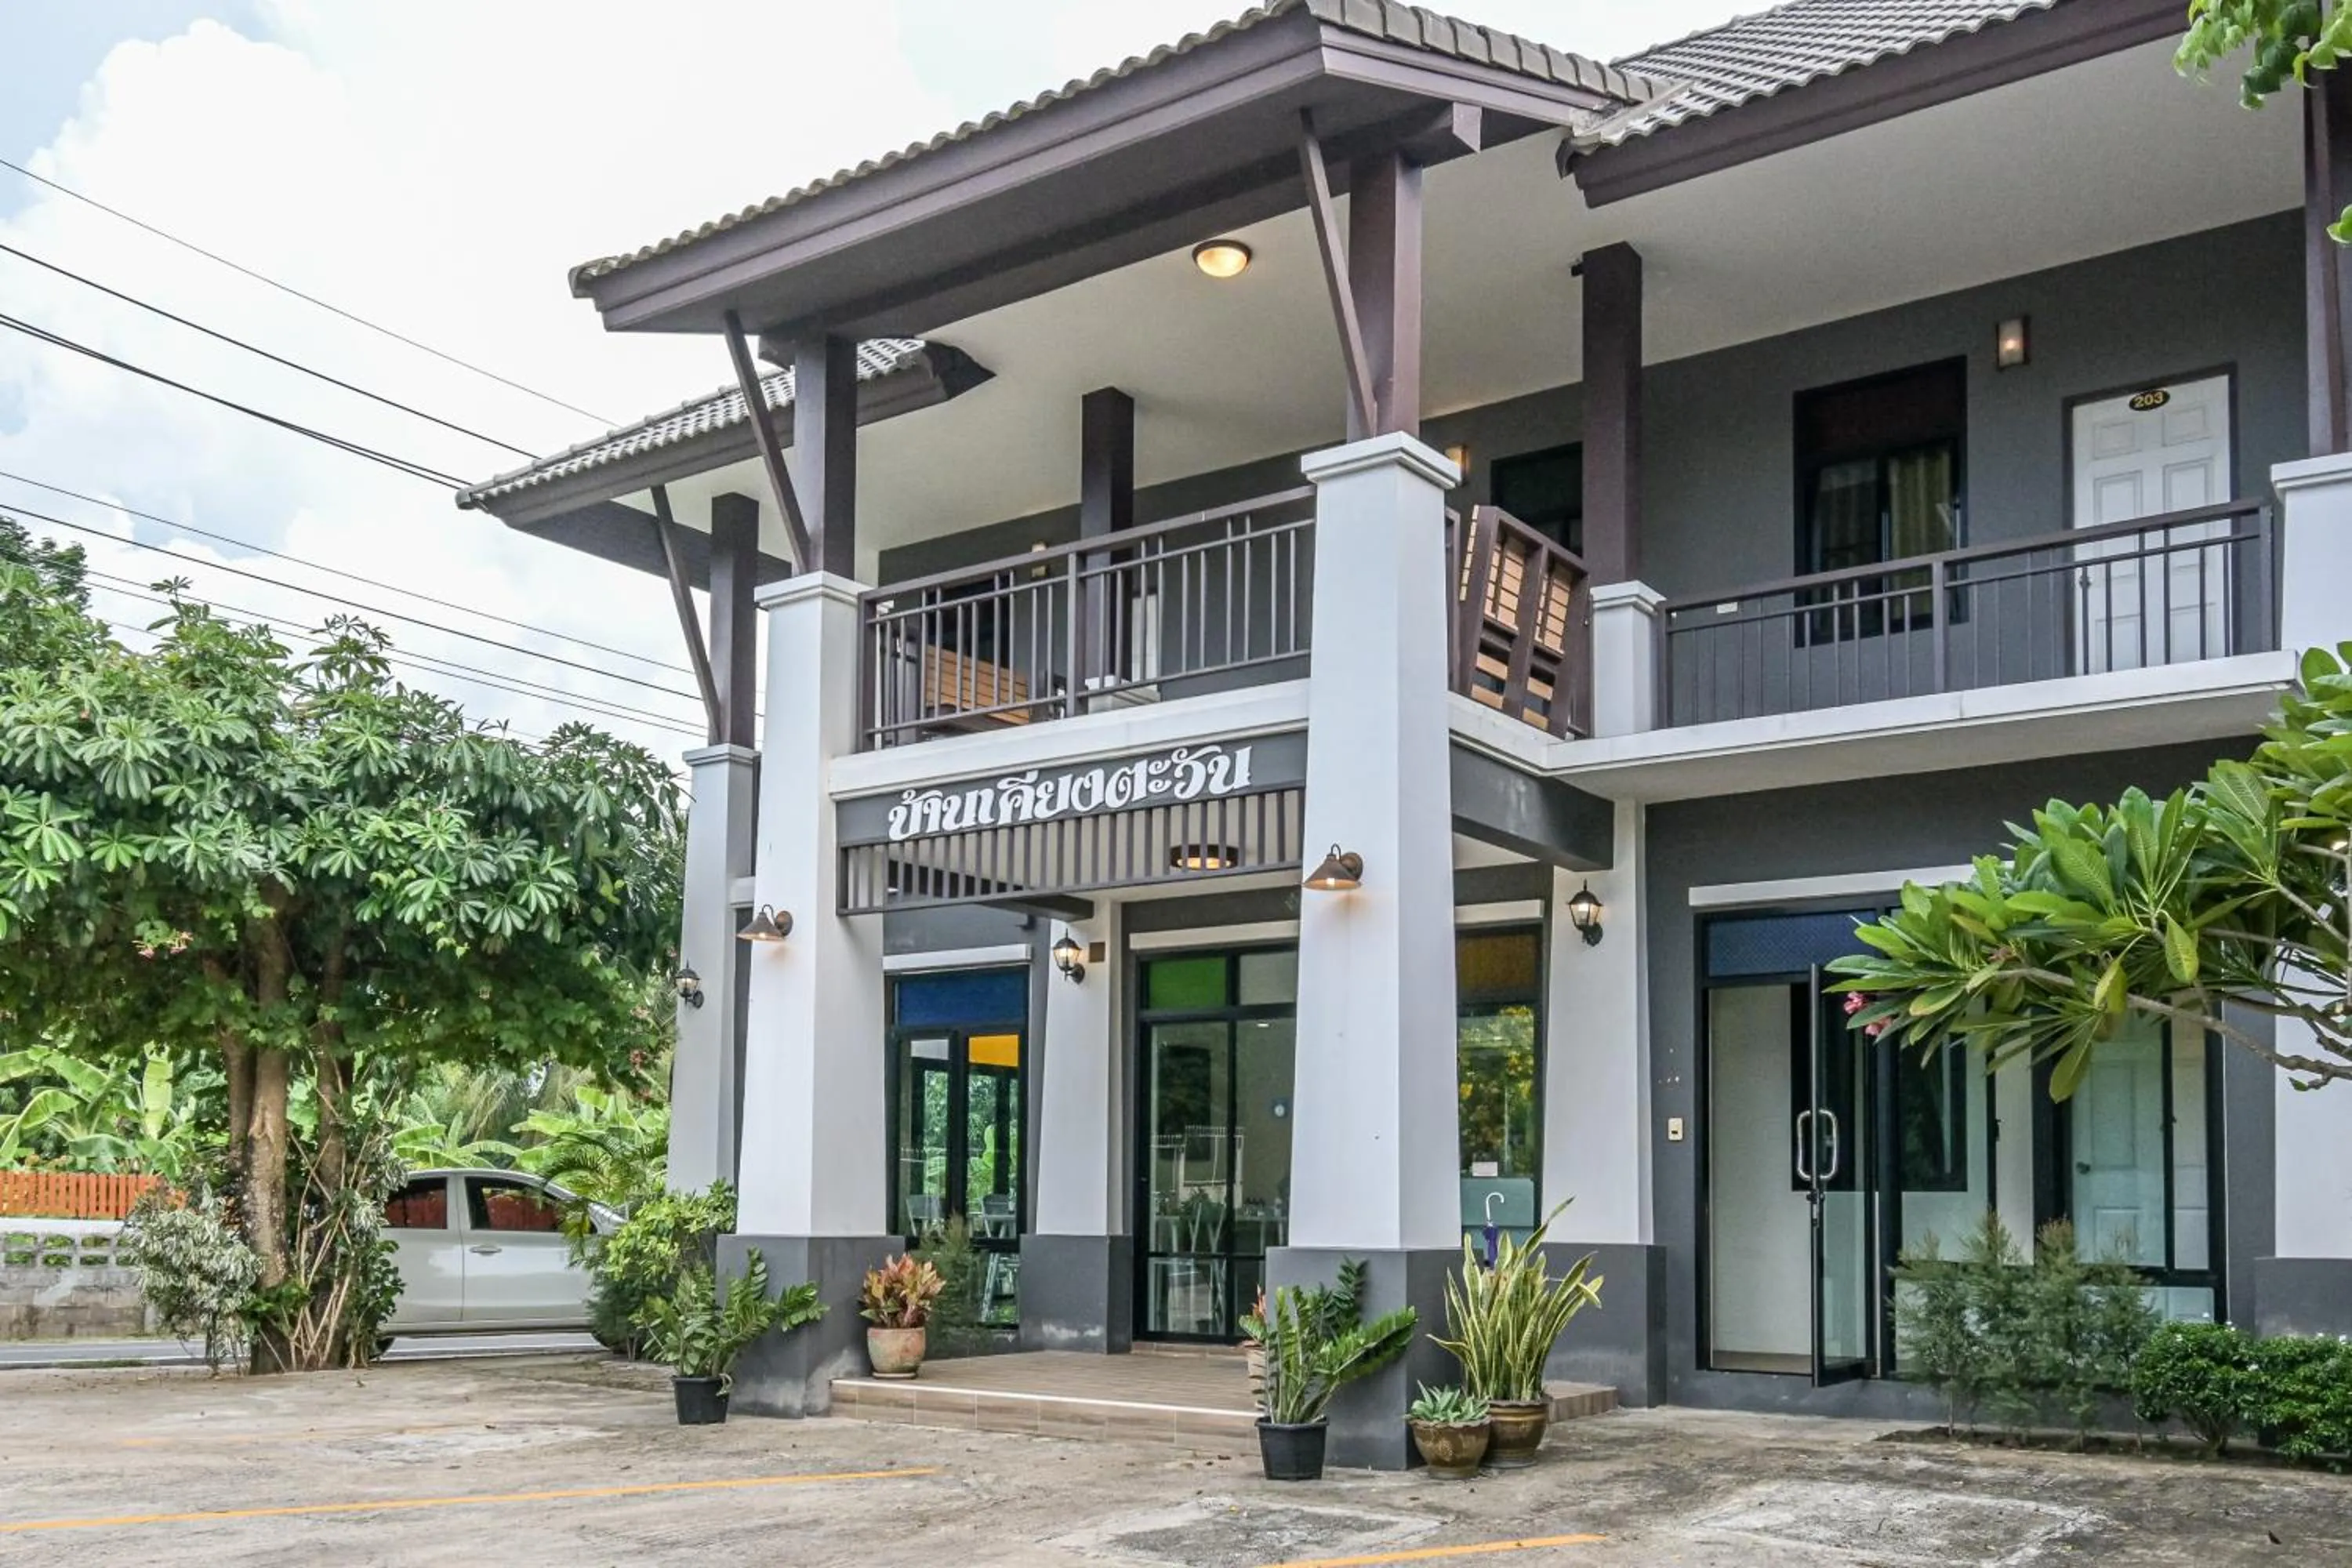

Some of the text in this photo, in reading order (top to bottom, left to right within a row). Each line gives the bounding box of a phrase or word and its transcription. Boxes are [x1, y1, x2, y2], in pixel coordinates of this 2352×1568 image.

[2134, 391, 2164, 408] 203
[888, 744, 1253, 841] บ้านเคียงตะวัน
